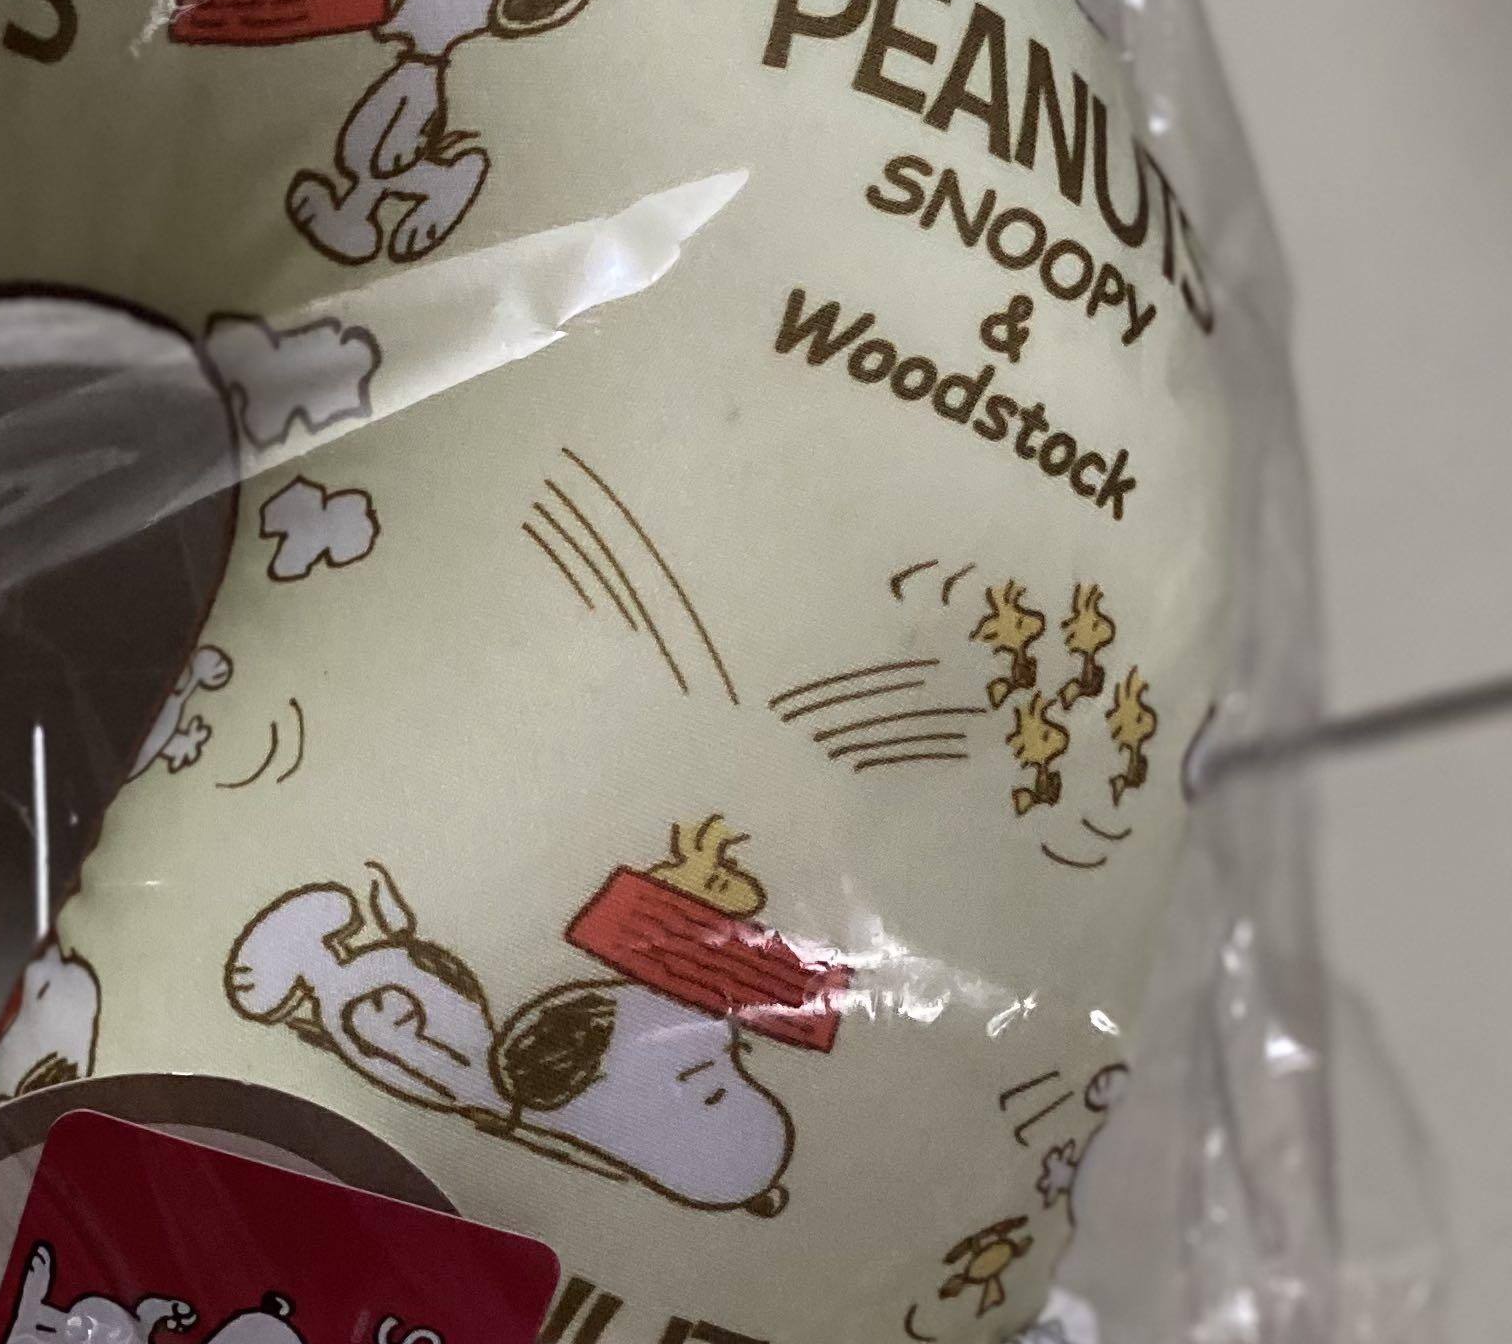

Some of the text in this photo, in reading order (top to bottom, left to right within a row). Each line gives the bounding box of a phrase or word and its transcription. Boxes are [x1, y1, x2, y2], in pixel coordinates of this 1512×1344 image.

[865, 153, 1157, 346] SNOOPY
[979, 294, 1034, 363] &
[773, 288, 1137, 521] Woodstock
